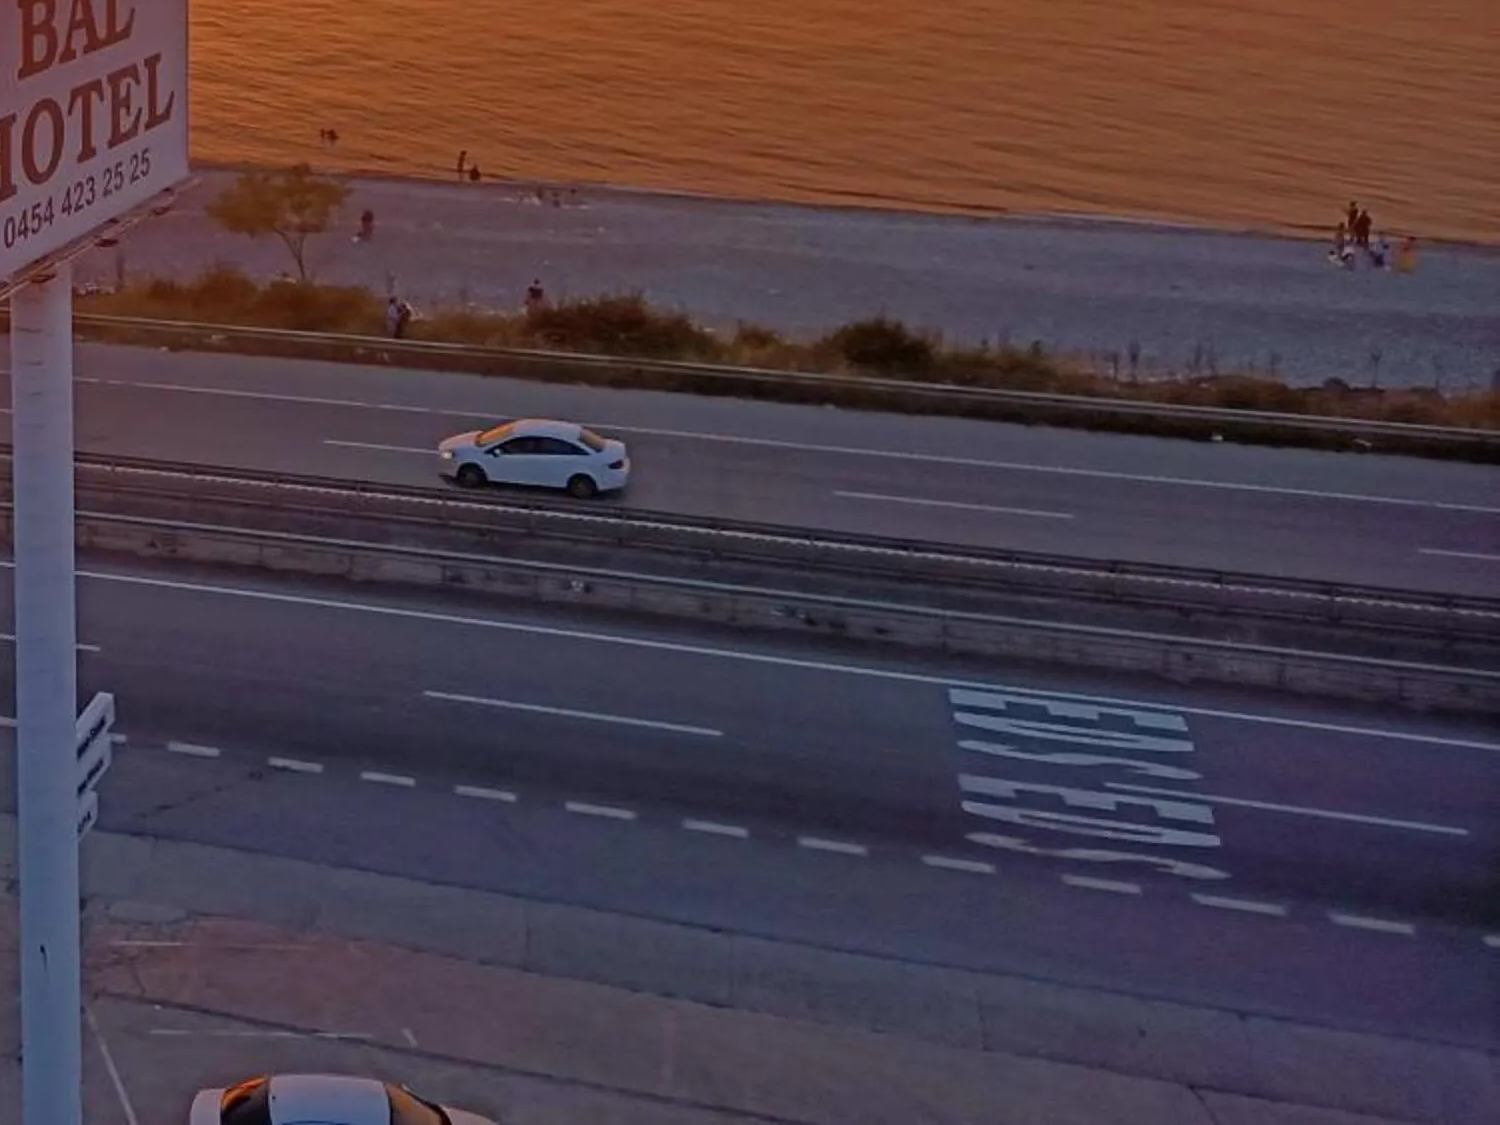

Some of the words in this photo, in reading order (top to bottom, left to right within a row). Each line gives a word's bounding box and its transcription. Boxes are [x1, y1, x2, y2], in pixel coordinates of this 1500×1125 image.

[3, 196, 55, 249] 0454
[61, 175, 96, 216] 423
[103, 161, 124, 197] 25
[130, 147, 151, 184] 25
